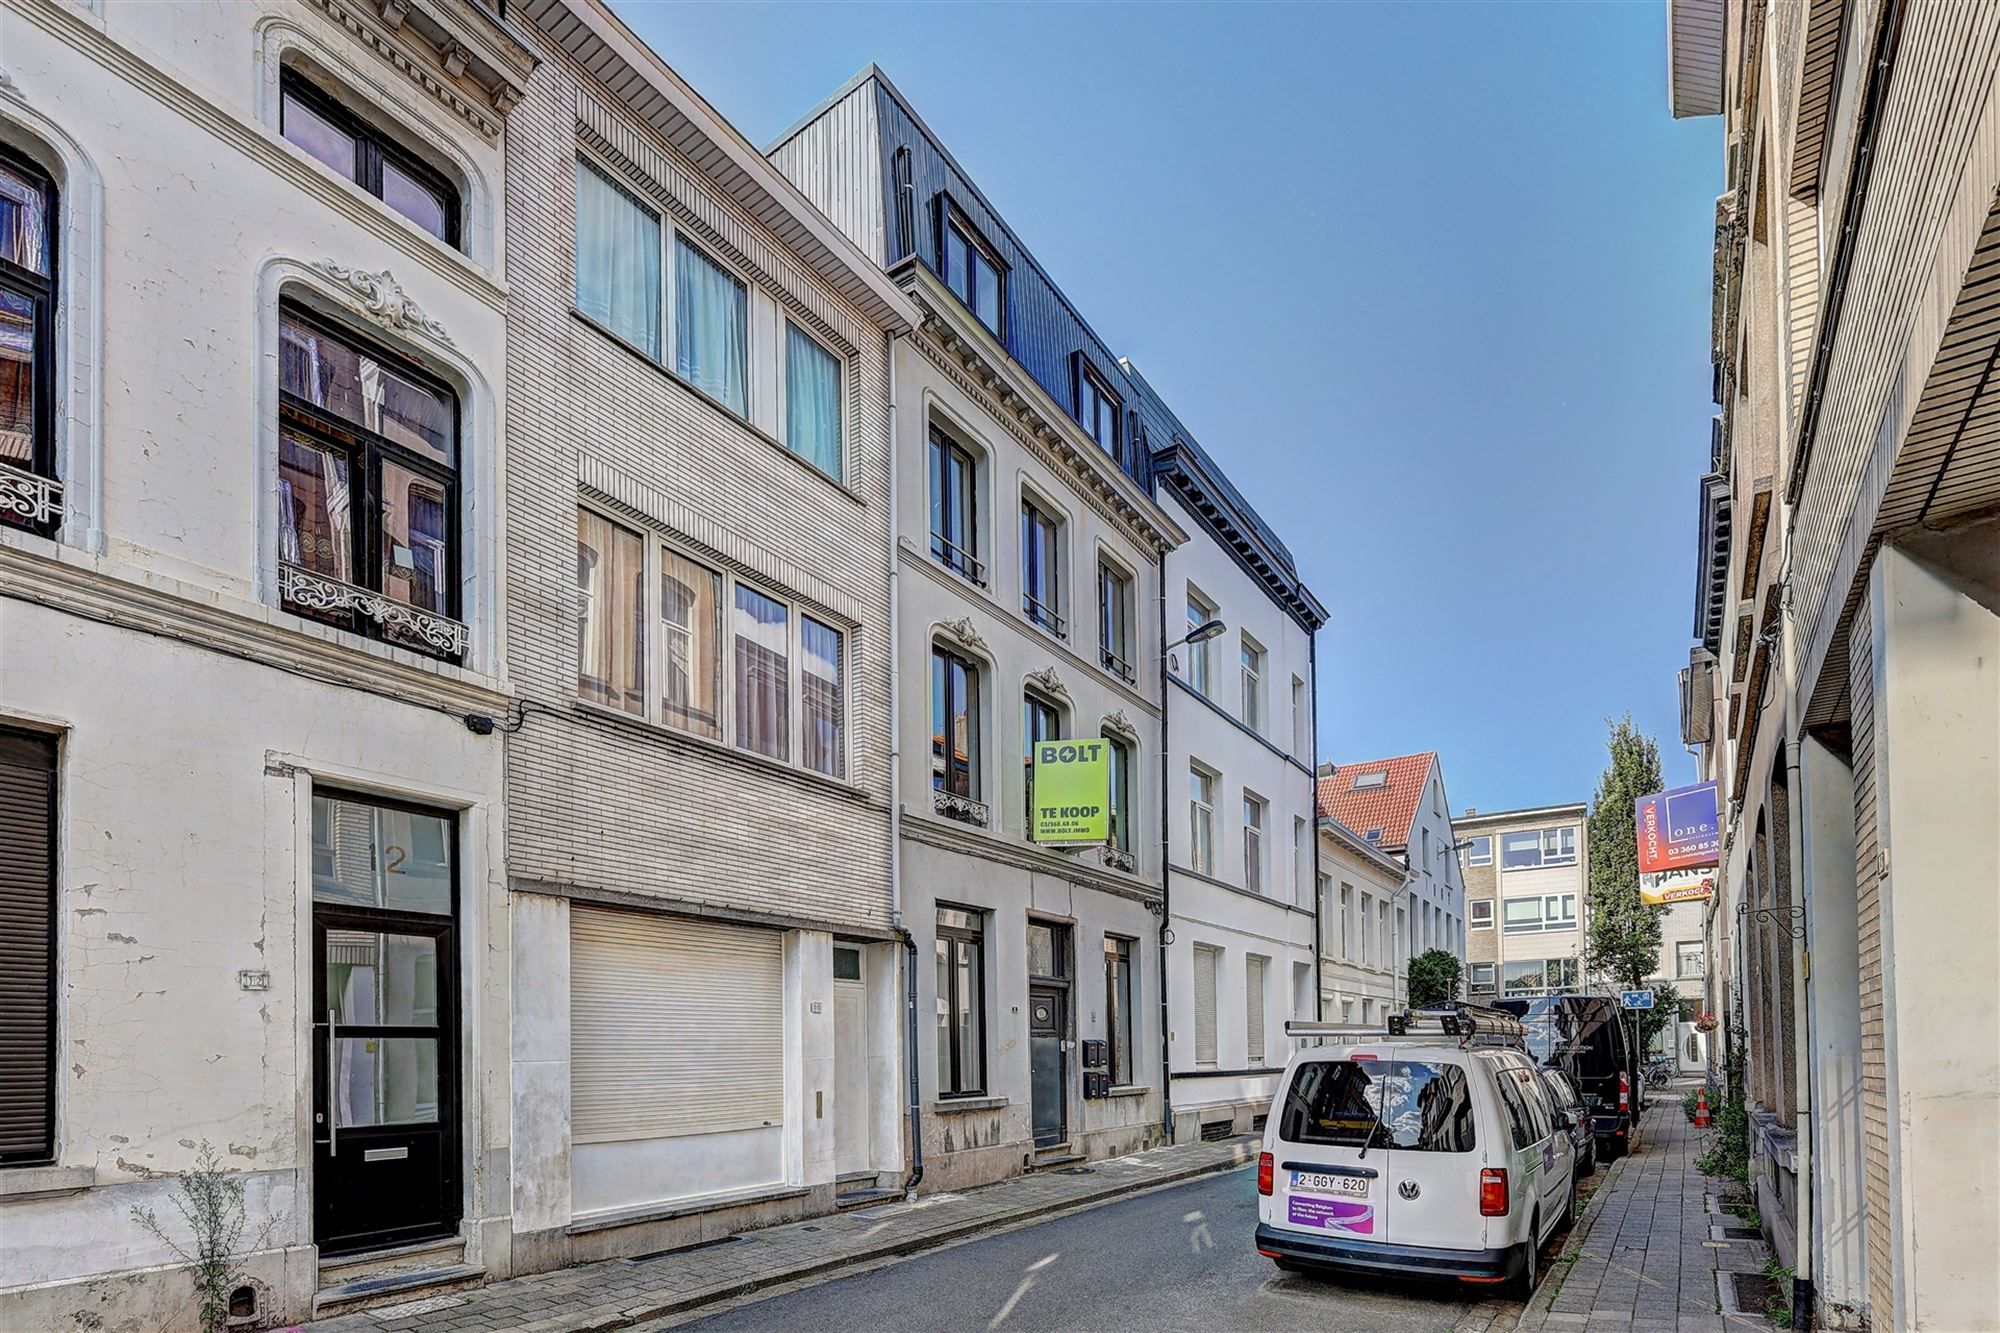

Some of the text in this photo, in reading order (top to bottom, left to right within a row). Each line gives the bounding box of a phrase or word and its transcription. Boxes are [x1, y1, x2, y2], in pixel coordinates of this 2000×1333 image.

[1041, 744, 1101, 764] BOLT
[1040, 806, 1100, 819] TE KOOP
[1646, 806, 1658, 859] VERKOCHT
[1668, 847, 1679, 856] 03
[1680, 844, 1697, 854] 360
[1698, 841, 1709, 850] 85
[1292, 1200, 1334, 1211] Connecting Belgium
